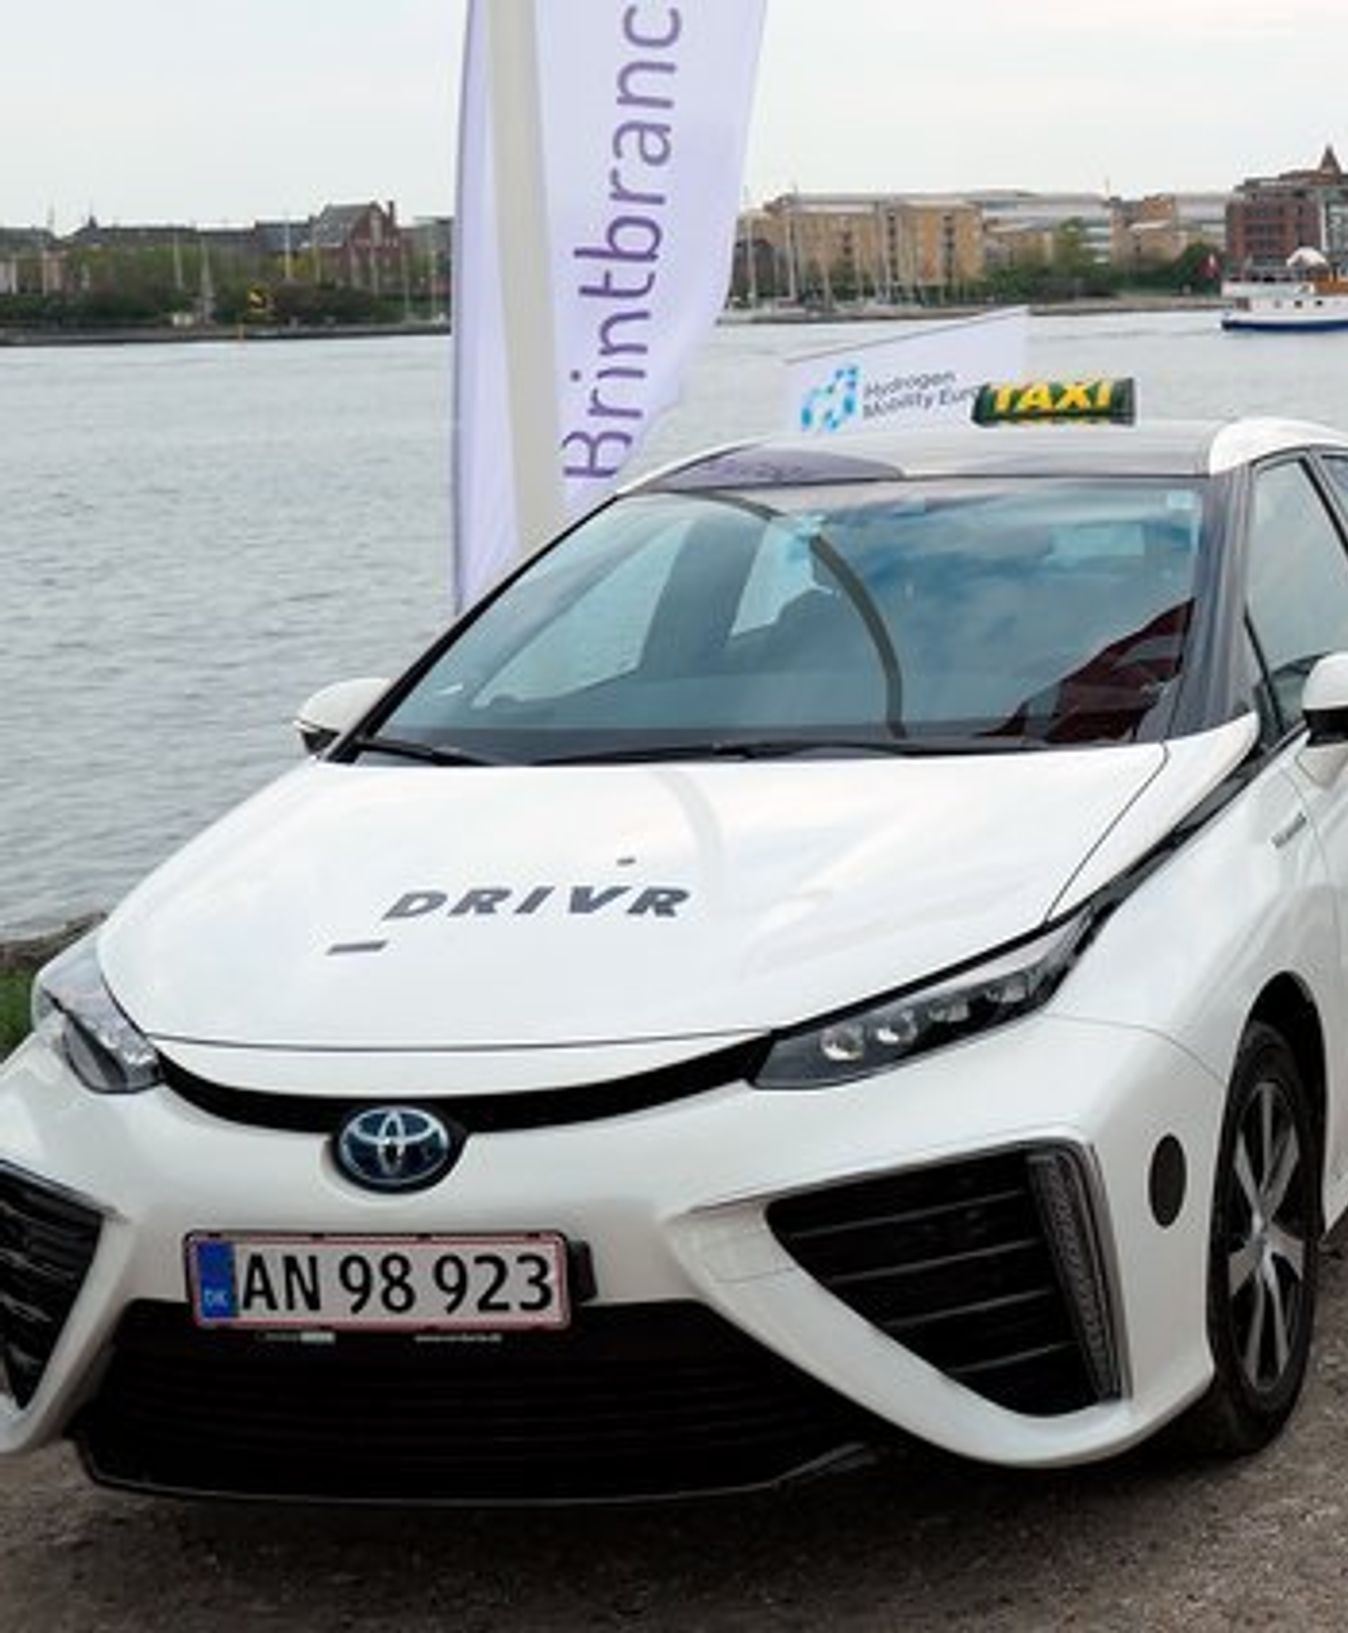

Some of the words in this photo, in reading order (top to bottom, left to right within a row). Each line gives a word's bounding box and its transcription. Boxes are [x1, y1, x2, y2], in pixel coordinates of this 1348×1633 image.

[560, 5, 682, 481] Brintbranc
[863, 370, 956, 400] Hydrogen
[991, 381, 1115, 413] TAXI
[862, 393, 933, 418] Mobility
[381, 885, 692, 921] DRIVR
[242, 1253, 321, 1311] AN
[338, 1253, 416, 1314] 98
[432, 1254, 554, 1314] 923
